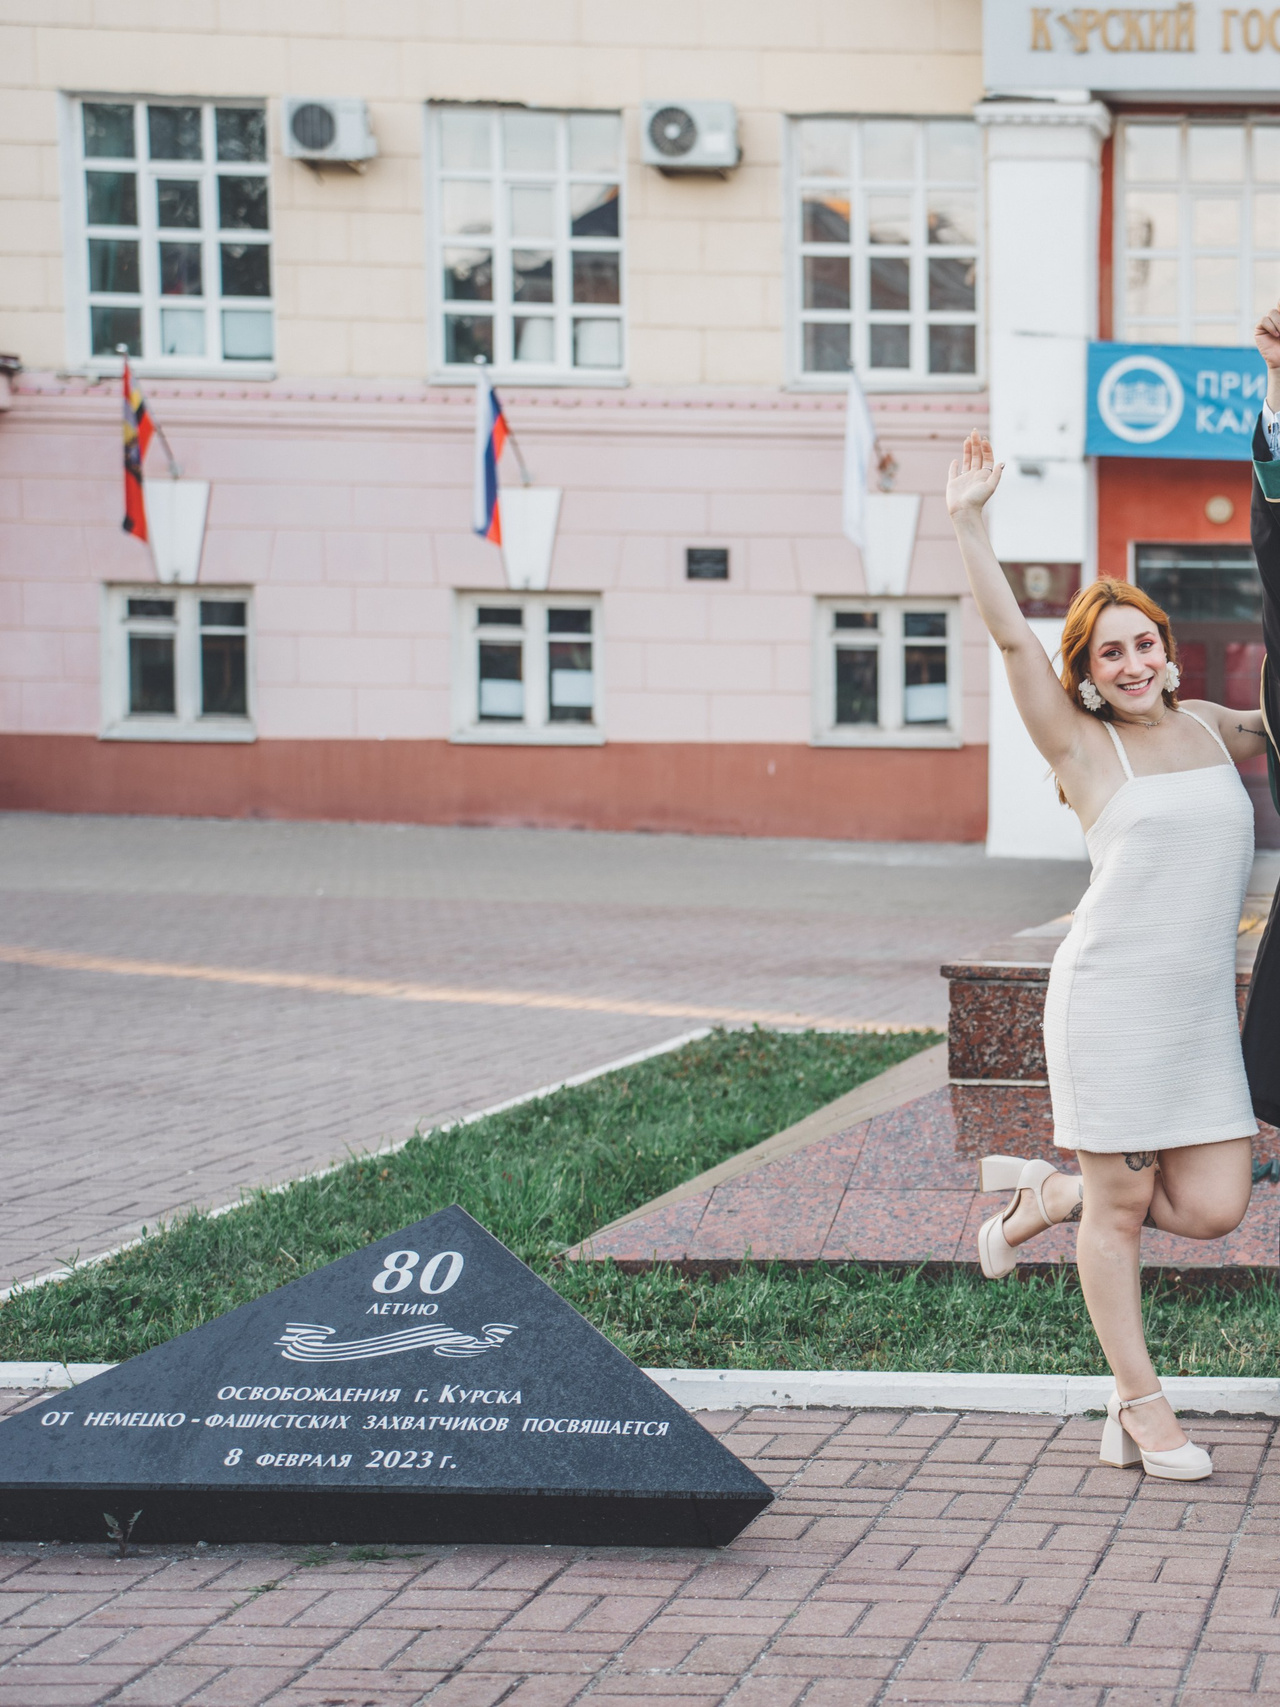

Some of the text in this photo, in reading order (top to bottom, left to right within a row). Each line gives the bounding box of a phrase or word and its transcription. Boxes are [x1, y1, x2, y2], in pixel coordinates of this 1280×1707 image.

[1030, 3, 1196, 54] КУРСКИЙ
[372, 1250, 464, 1295] 80
[365, 1302, 439, 1316] ЛЕТИЮ
[217, 1385, 401, 1403] ОСВОБОЖДЕНИЯ
[41, 1411, 74, 1426] ОТ
[362, 1415, 509, 1432] ЗАХВАТЧИКОВ
[223, 1448, 243, 1466] 8
[255, 1453, 352, 1468] ФЕВРАЛЯ
[365, 1449, 434, 1469] 2023
